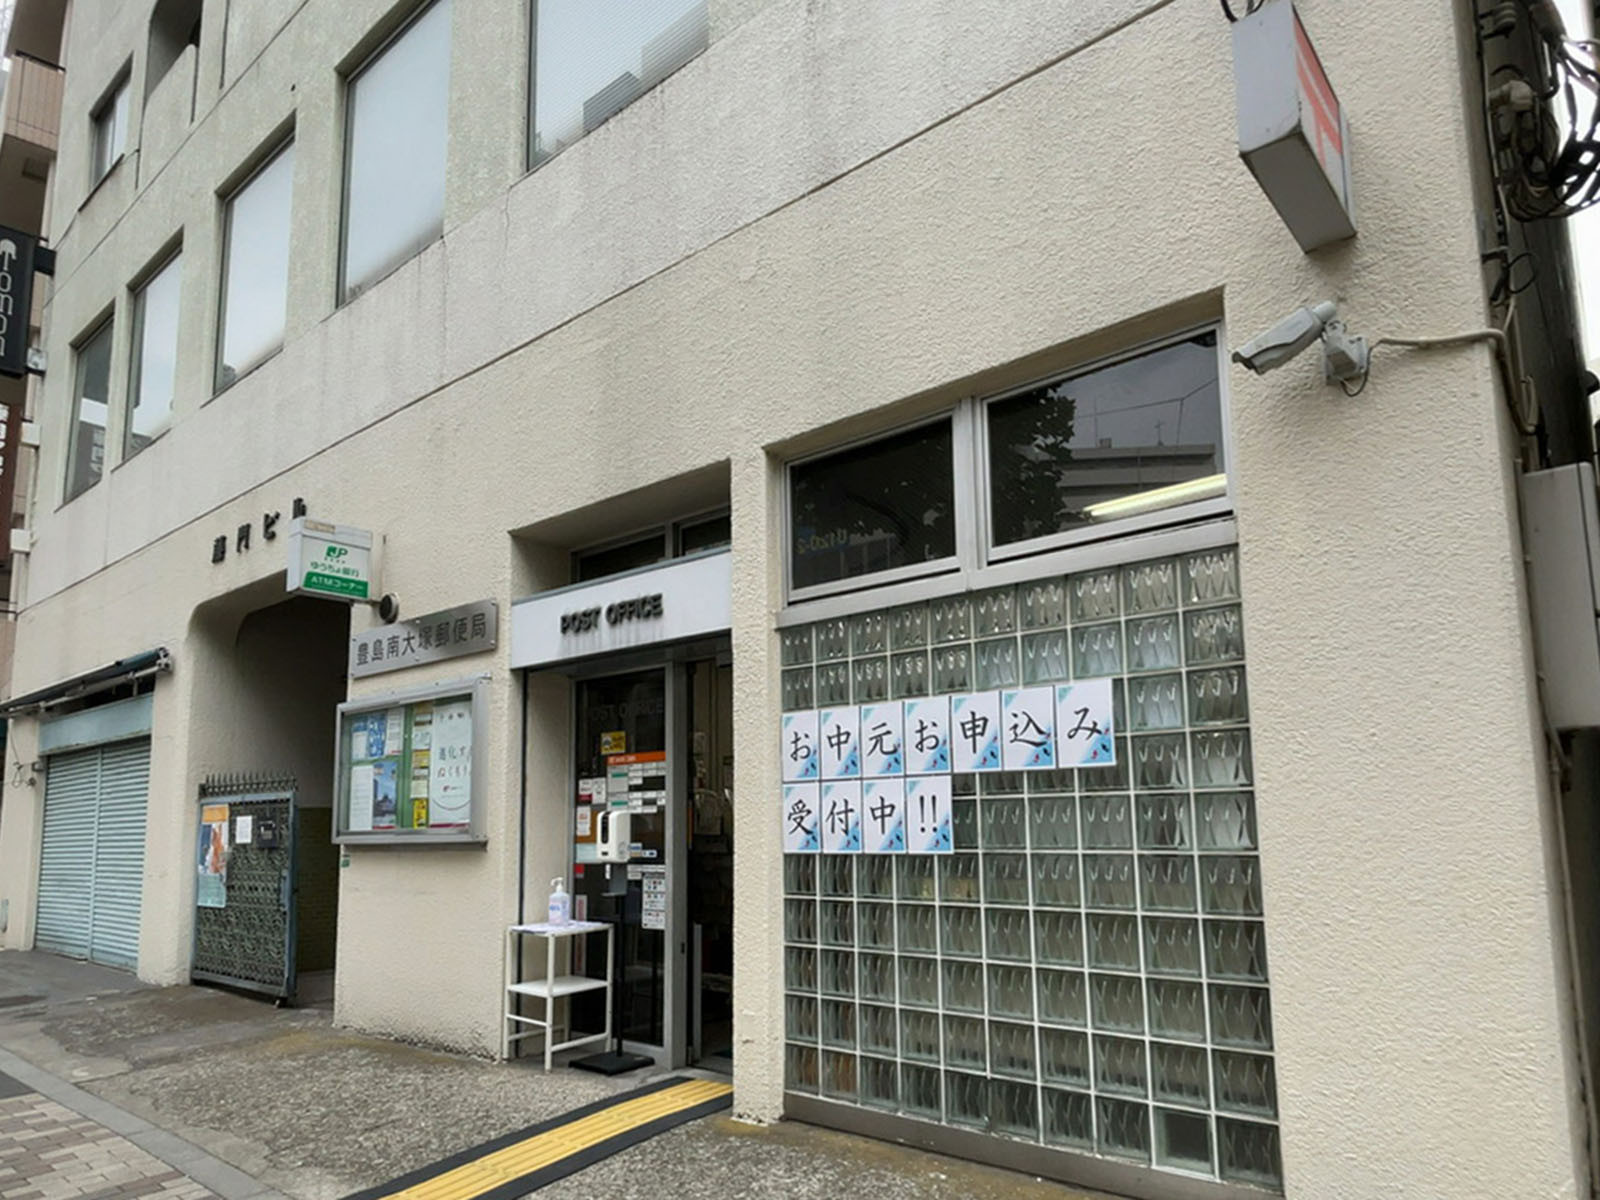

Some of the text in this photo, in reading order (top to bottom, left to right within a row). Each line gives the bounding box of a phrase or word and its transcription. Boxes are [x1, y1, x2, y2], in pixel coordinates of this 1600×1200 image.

[311, 576, 365, 591] ATMコーナー
[560, 592, 664, 634] POST OFFICE
[355, 612, 487, 667] 豊島南大塚郵便局
[789, 705, 1102, 762] お中元お申込み
[786, 794, 938, 836] 受付中!!
